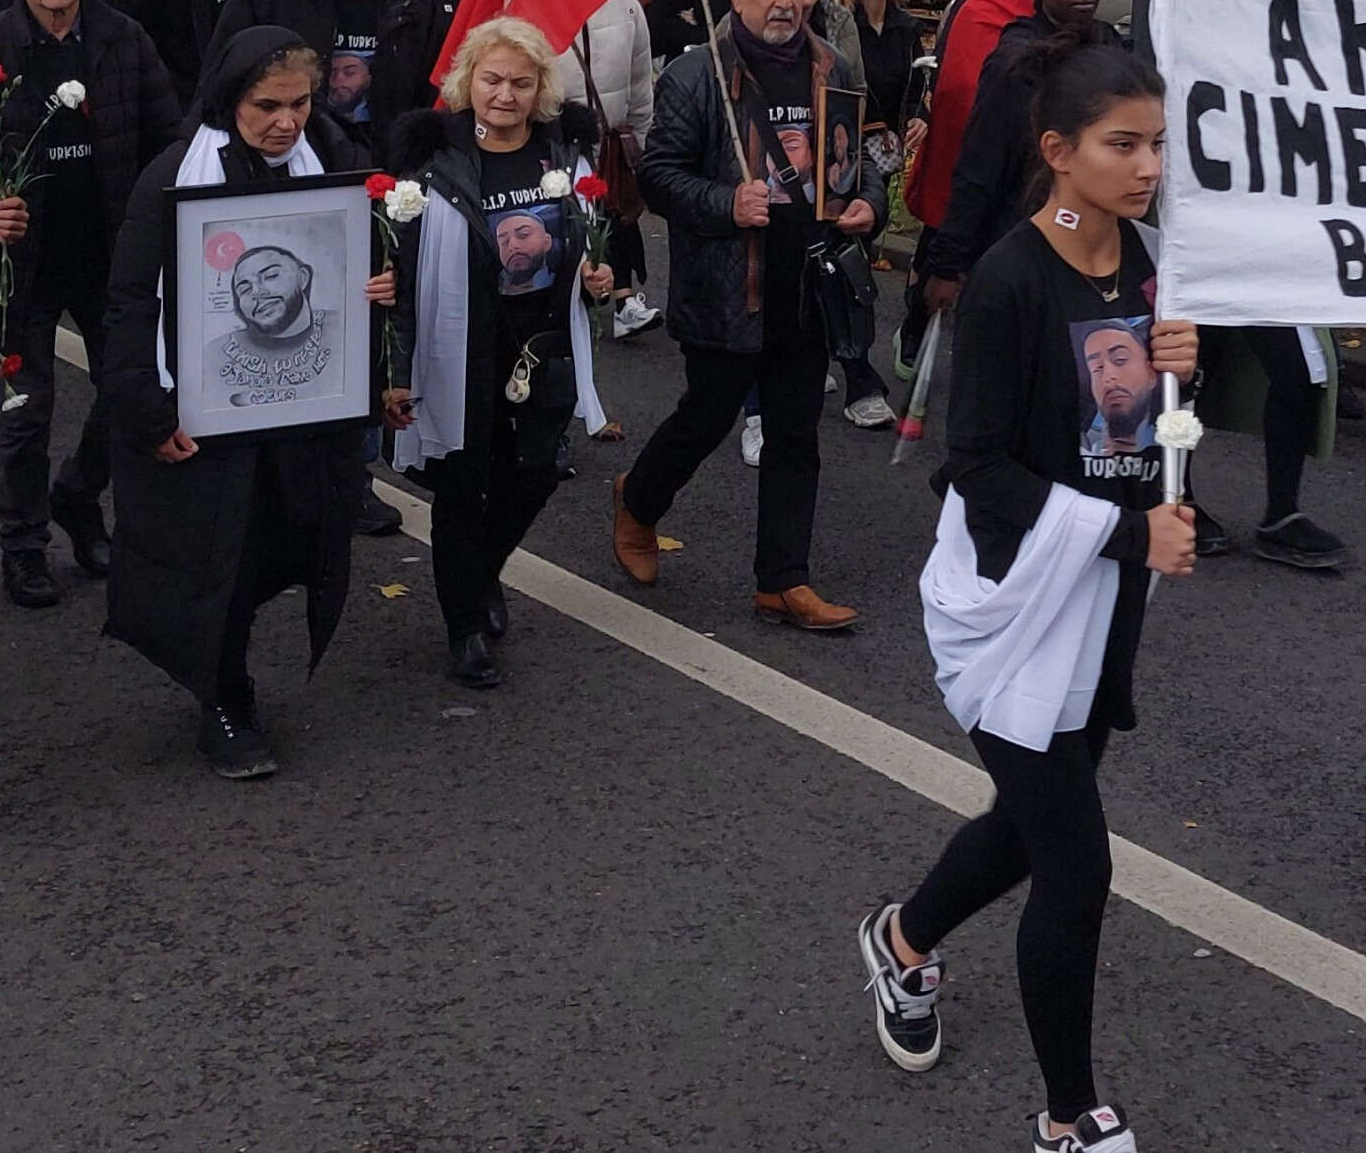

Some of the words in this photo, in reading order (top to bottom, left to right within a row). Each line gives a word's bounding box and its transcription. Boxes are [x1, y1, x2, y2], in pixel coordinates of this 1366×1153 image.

[348, 35, 377, 49] TURKI
[48, 143, 92, 161] URKISH
[508, 186, 549, 206] TURKI
